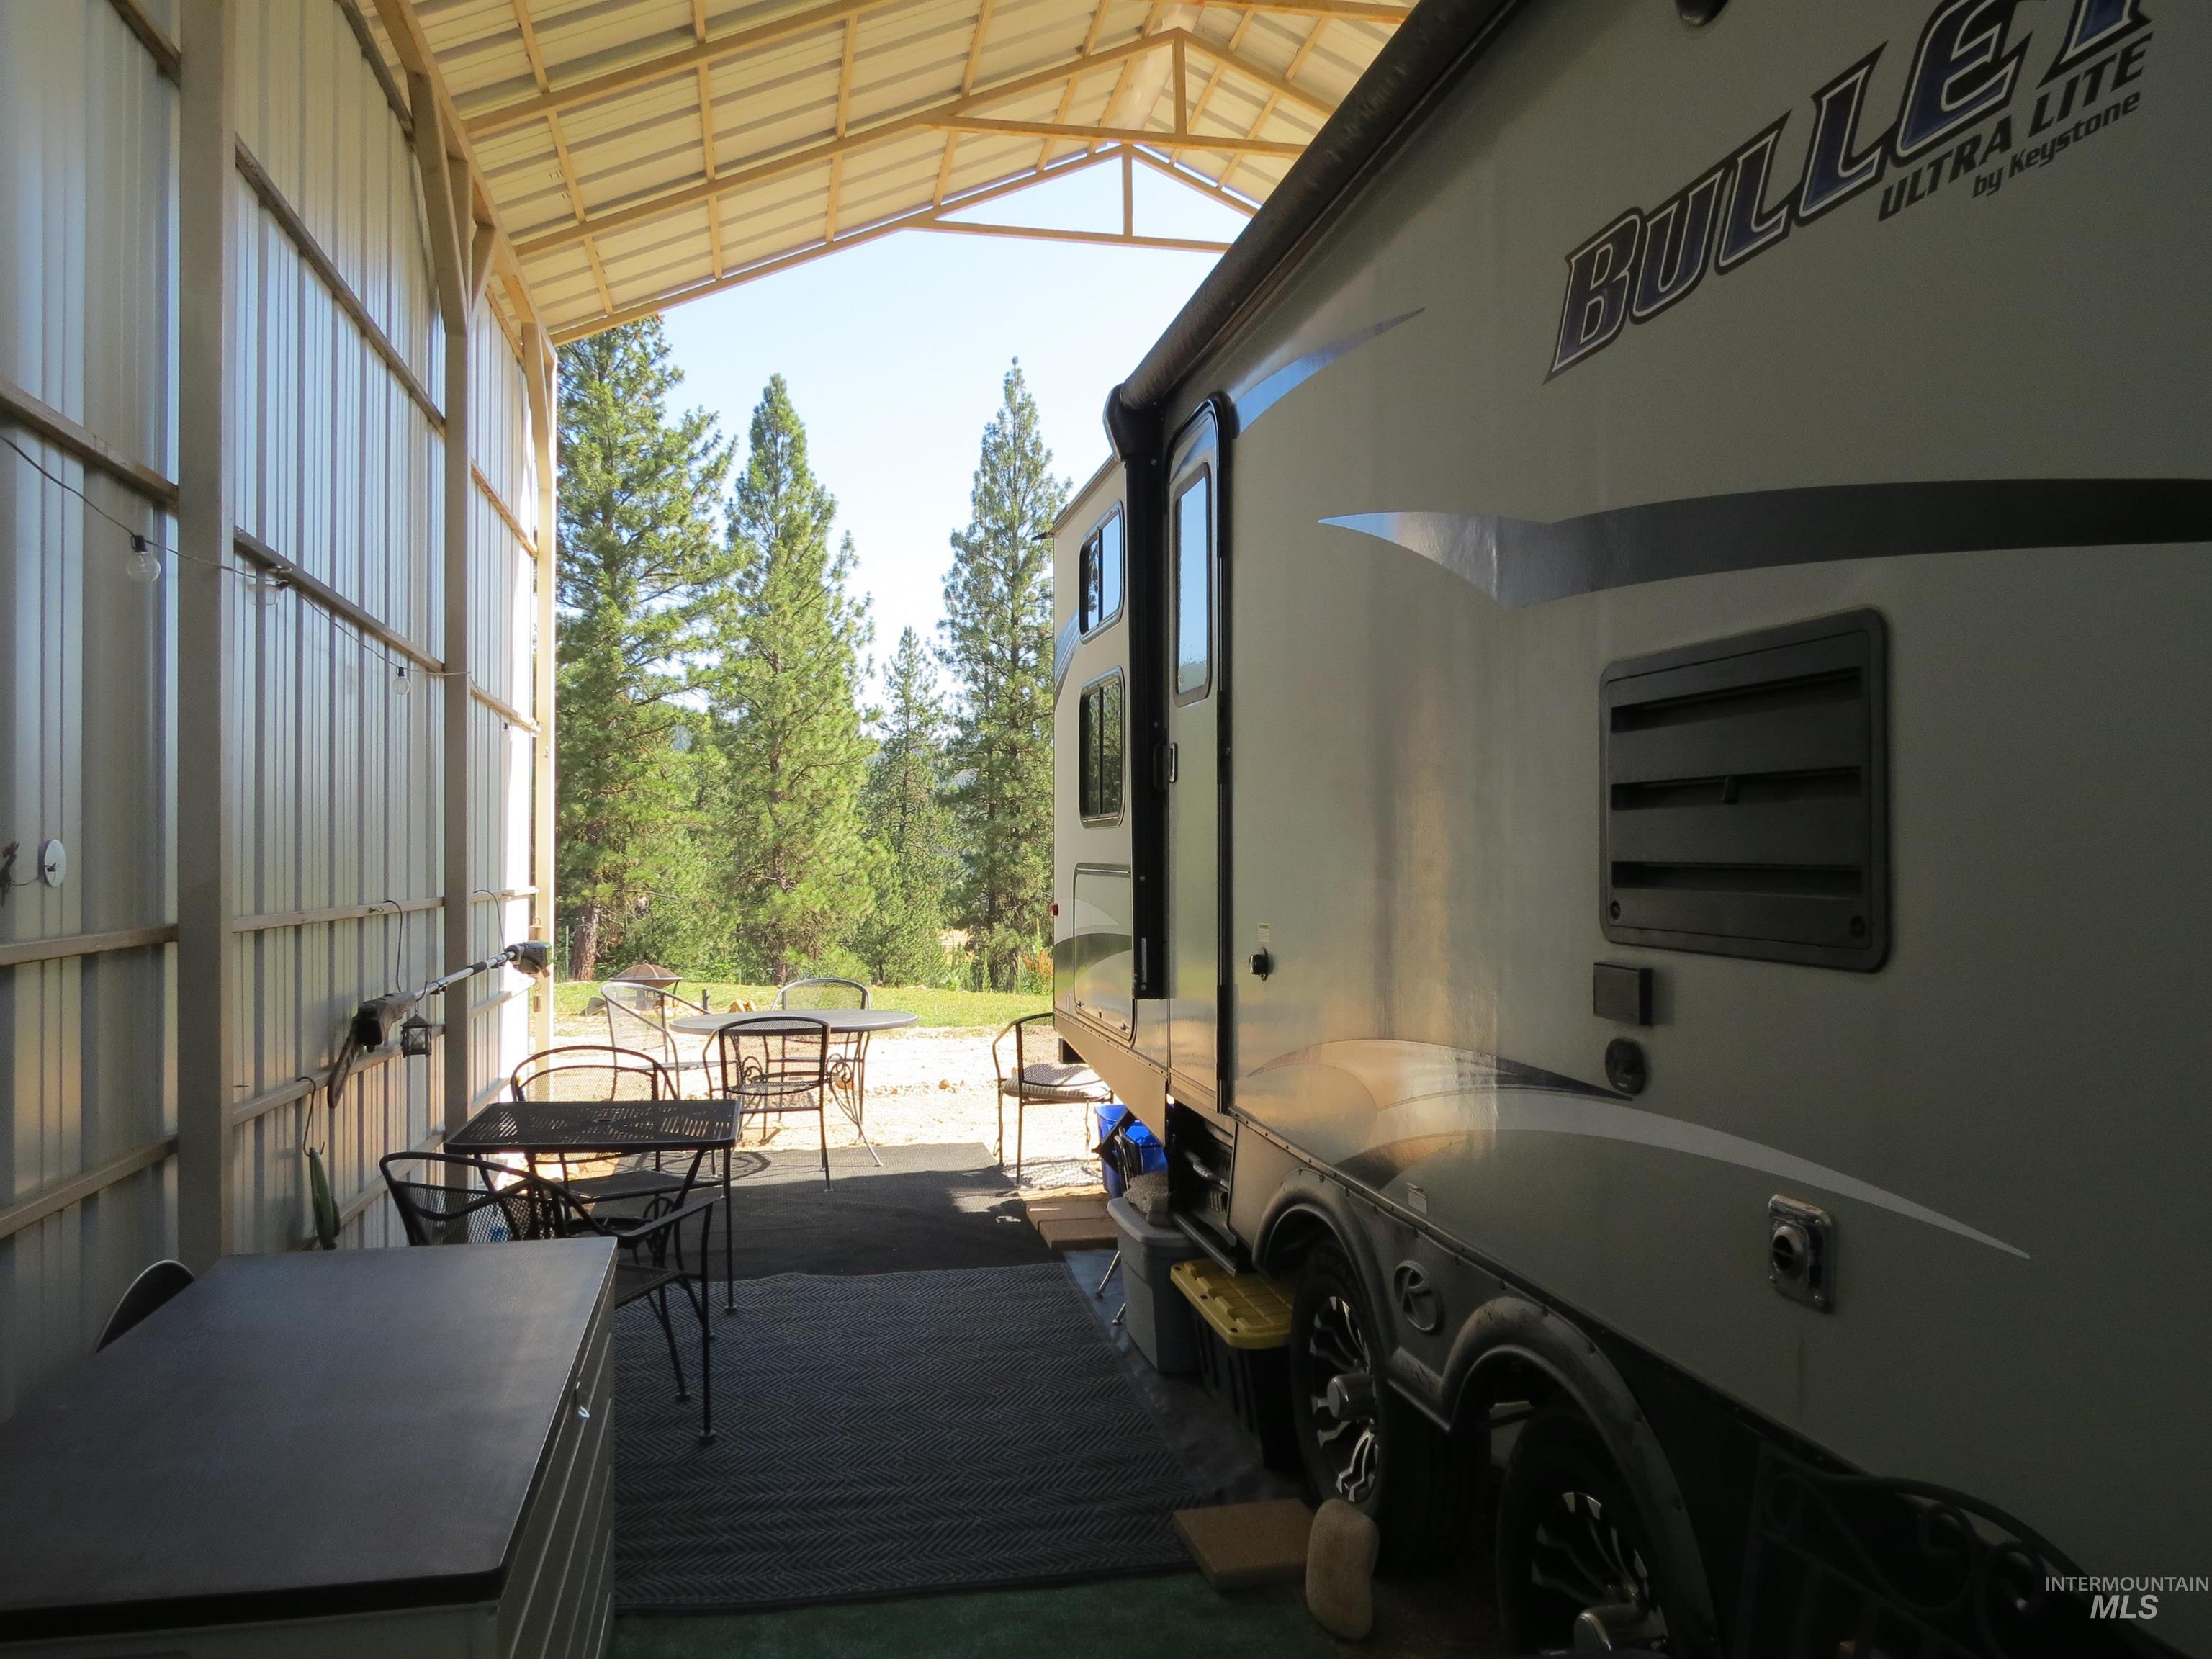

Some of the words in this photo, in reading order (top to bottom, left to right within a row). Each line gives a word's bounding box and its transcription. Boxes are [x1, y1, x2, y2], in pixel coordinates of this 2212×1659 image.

[1878, 115, 2013, 222] ULTRA
[2028, 32, 2153, 138] LITE
[1972, 167, 2003, 199] by
[2008, 91, 2141, 179] Keystone
